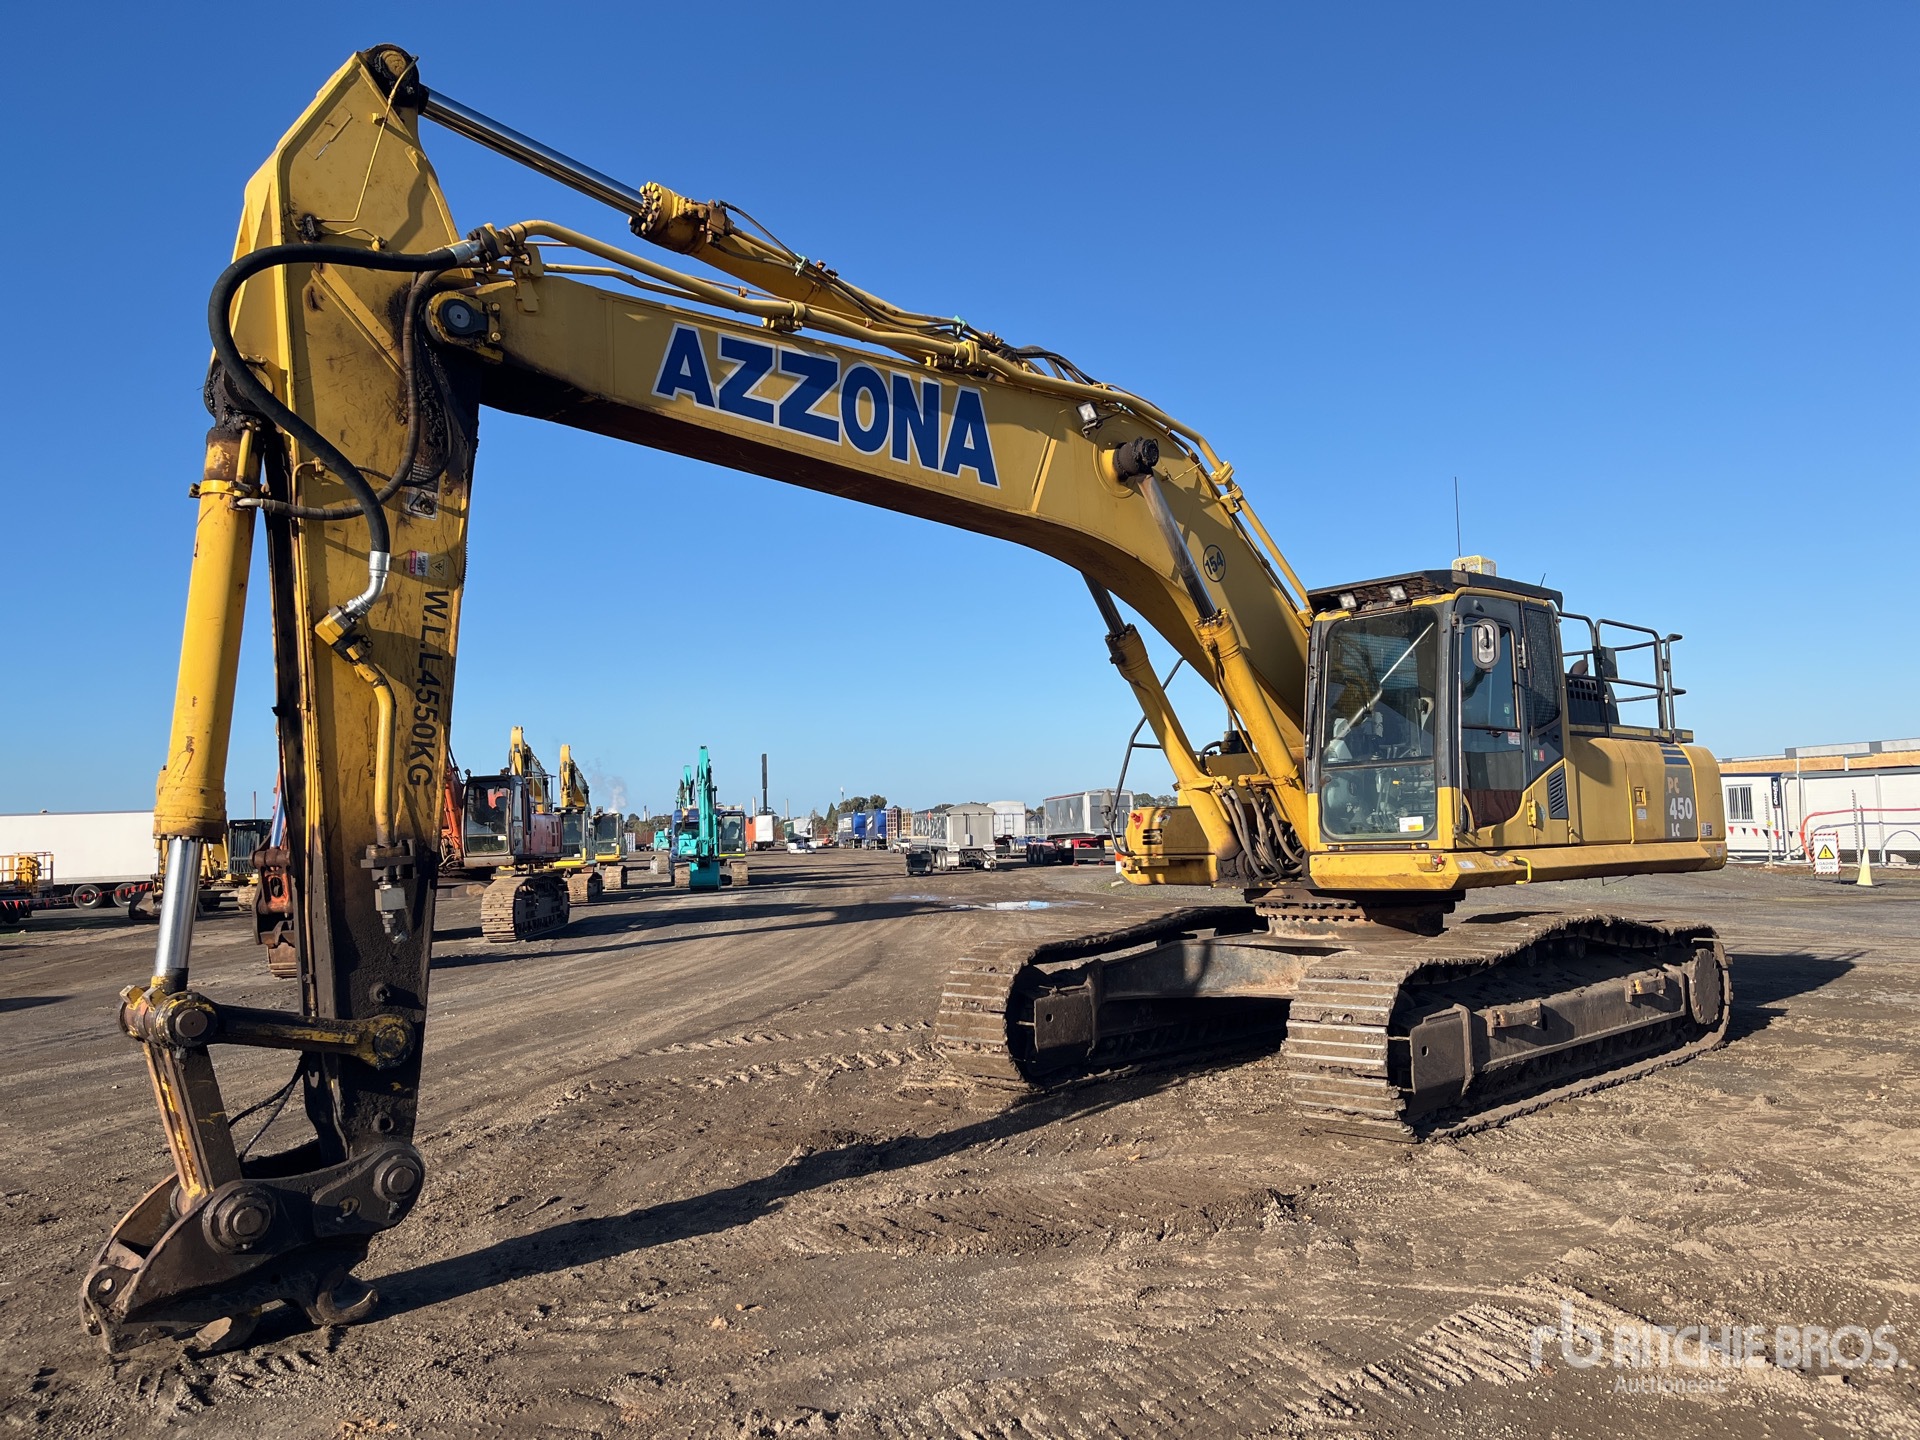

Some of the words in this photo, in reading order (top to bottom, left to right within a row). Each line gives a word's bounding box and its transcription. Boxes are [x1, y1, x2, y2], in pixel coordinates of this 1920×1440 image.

[651, 323, 1000, 489] AZZONA
[1205, 551, 1224, 575] 154
[1667, 776, 1680, 794] PC
[1670, 797, 1693, 820] 450
[1671, 823, 1680, 837] LC
